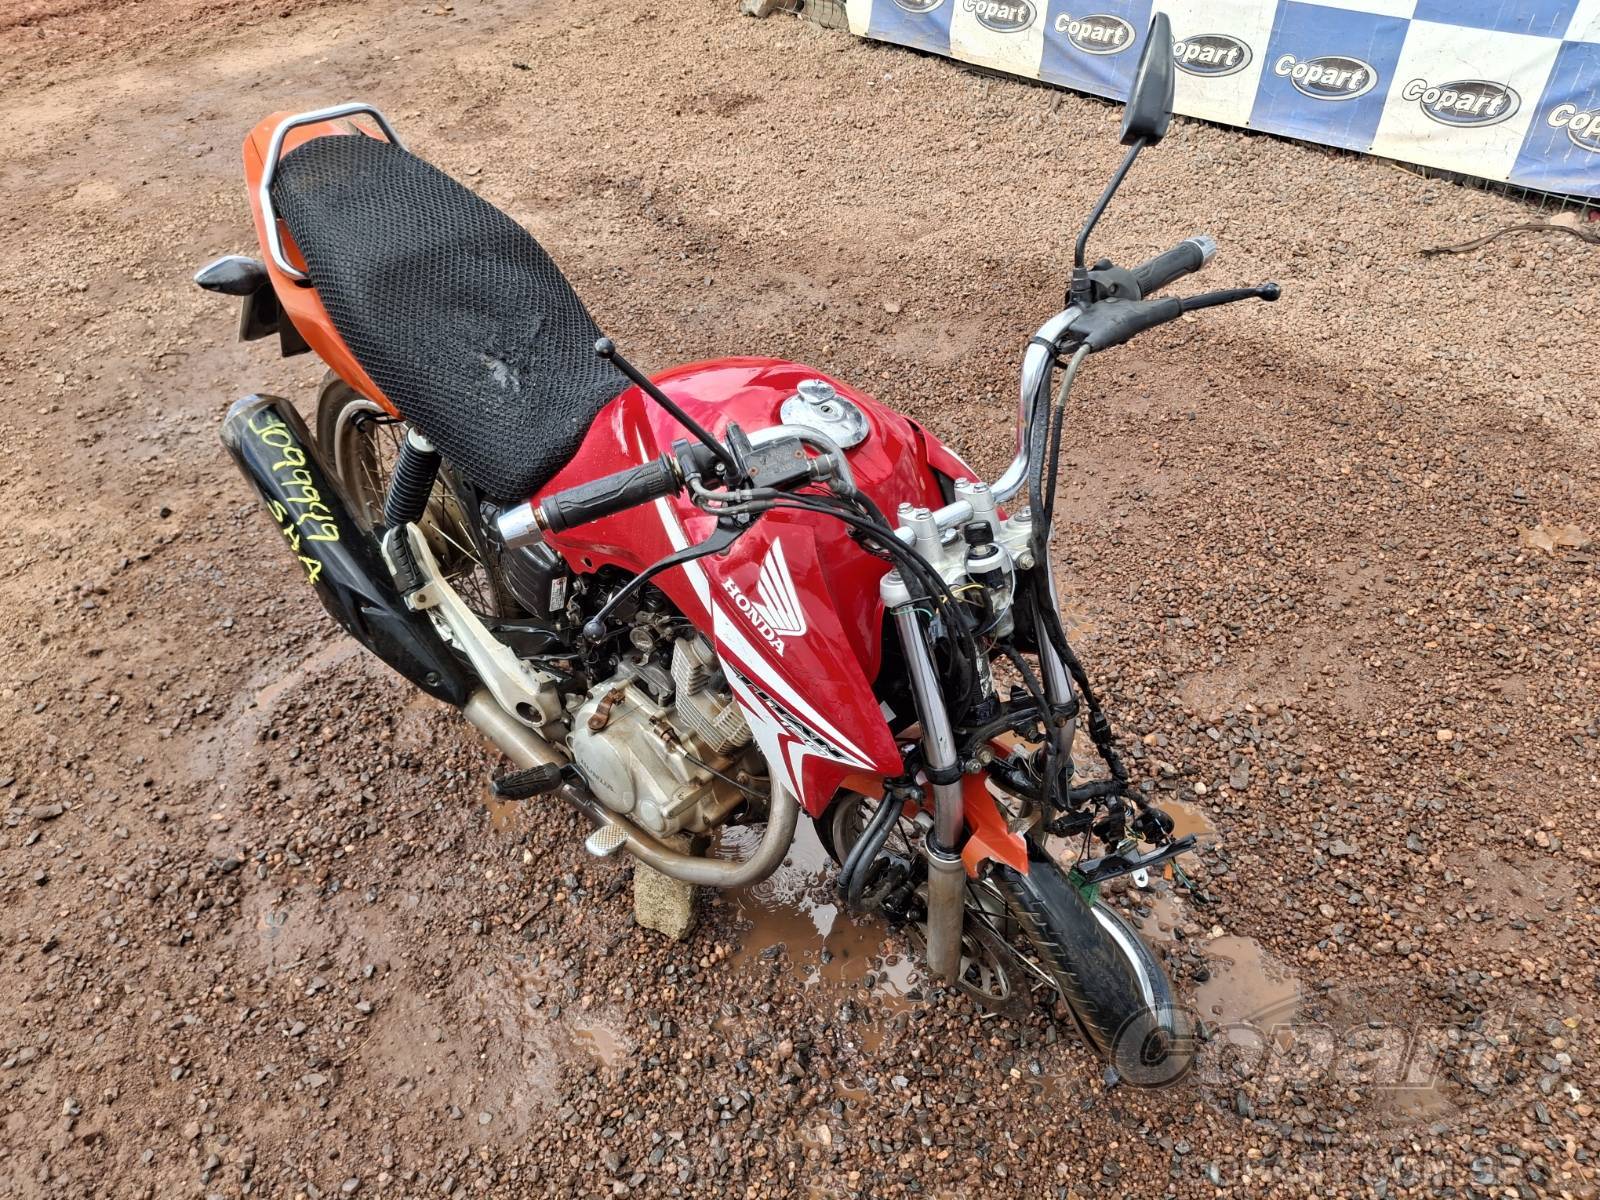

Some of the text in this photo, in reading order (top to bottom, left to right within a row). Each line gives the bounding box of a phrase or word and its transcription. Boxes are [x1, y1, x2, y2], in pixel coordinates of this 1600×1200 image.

[1054, 13, 1126, 46] Copart
[1172, 34, 1239, 67] opart
[1275, 53, 1365, 92] Copart
[1402, 78, 1505, 117] Copart
[721, 577, 784, 657] HONDA
